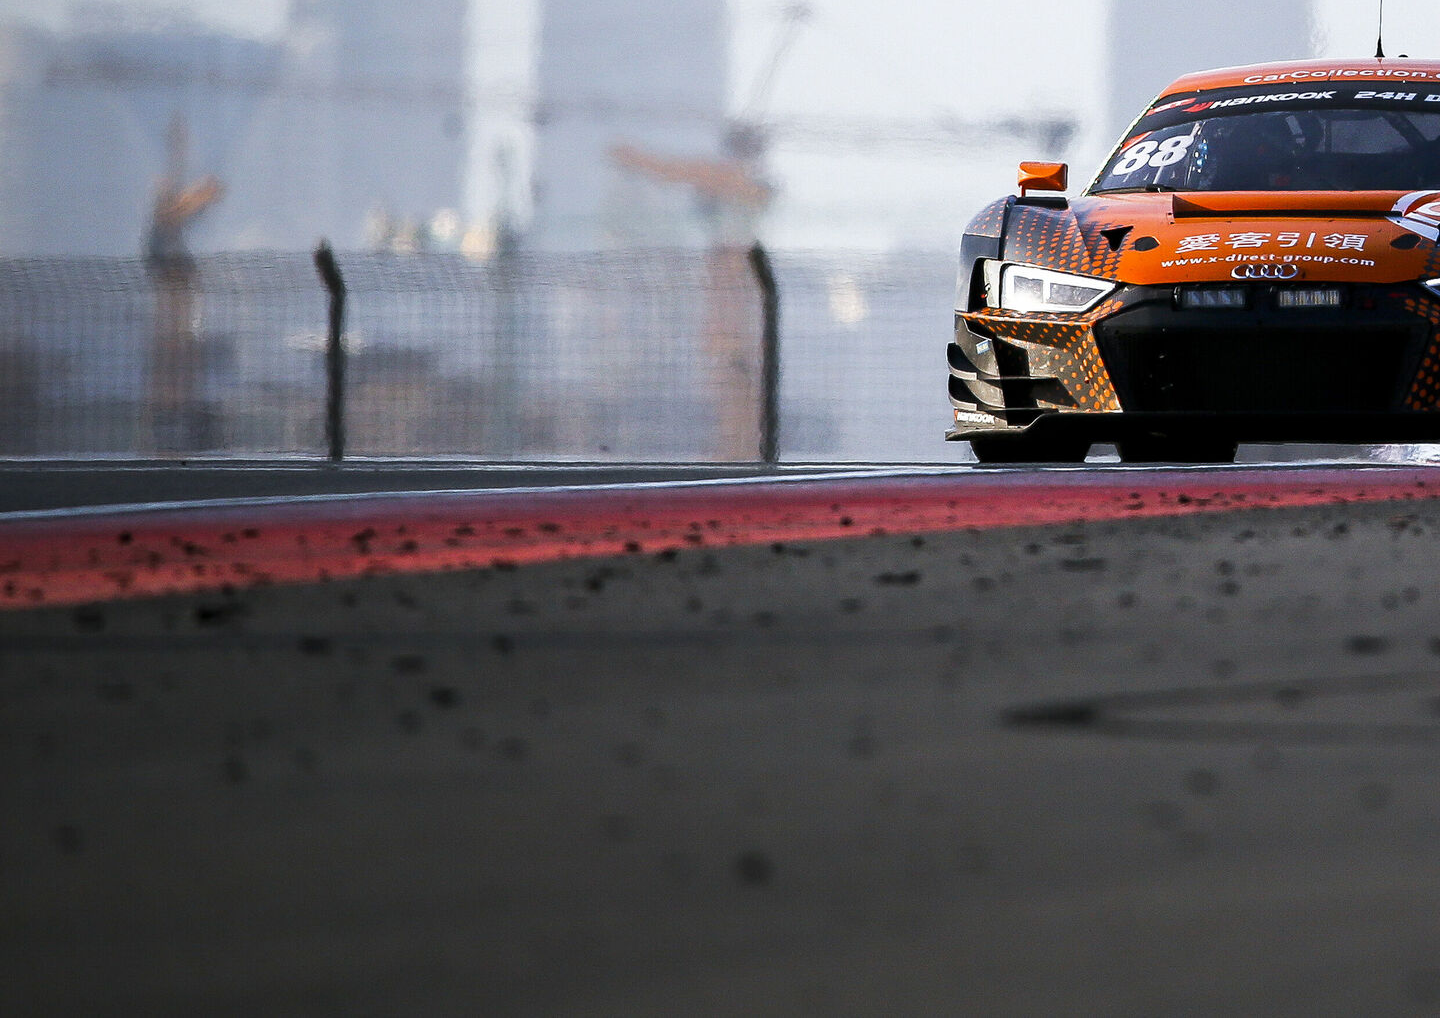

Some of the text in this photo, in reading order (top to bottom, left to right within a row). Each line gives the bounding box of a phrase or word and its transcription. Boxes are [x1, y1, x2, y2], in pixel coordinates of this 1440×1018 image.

[1354, 90, 1416, 101] 24H
[1112, 134, 1195, 176] 88
[1174, 232, 1369, 254] 愛客引領
[1160, 253, 1376, 268] www.x-direct-group.com
